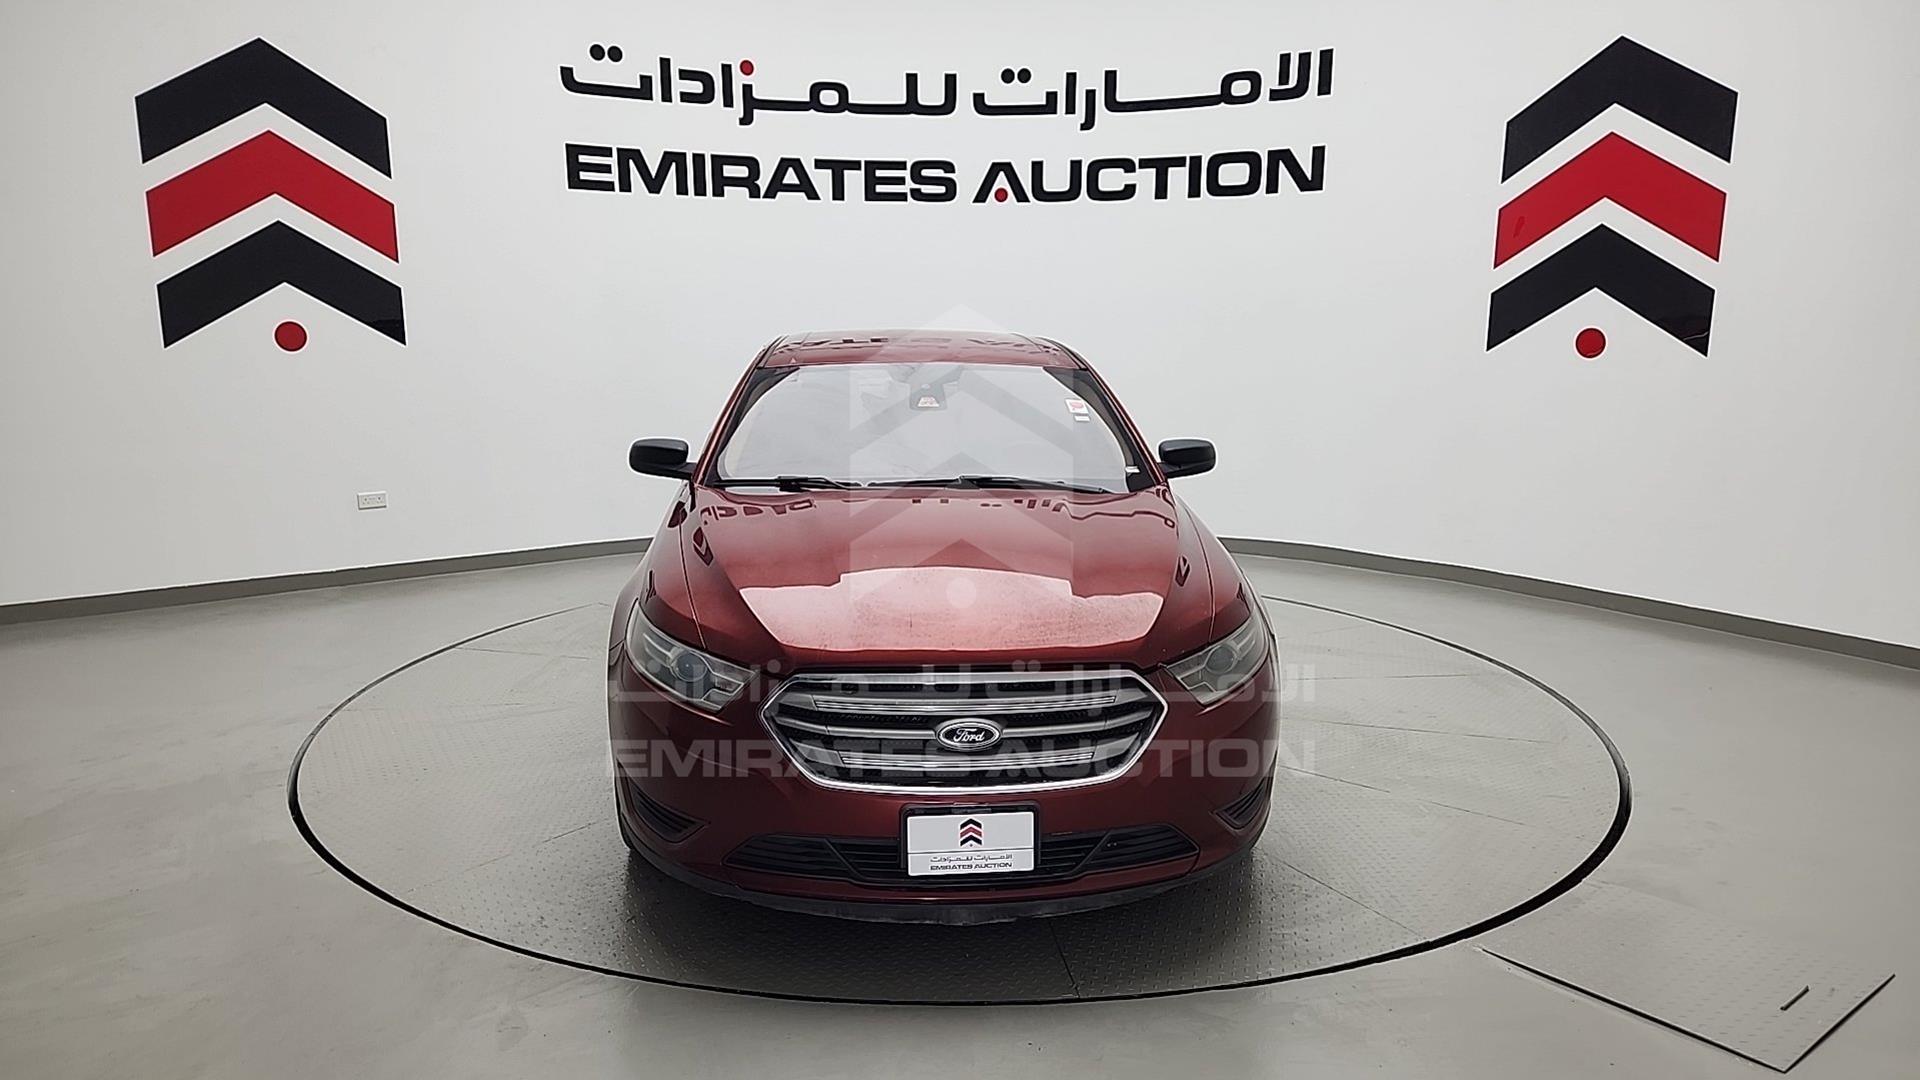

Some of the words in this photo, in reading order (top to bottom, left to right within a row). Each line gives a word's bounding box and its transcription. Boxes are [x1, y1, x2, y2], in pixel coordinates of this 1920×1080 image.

[560, 44, 956, 125] للمزادات
[565, 143, 957, 202] EMIRATES
[973, 146, 1325, 203] AUCTION
[953, 728, 986, 742] Ford
